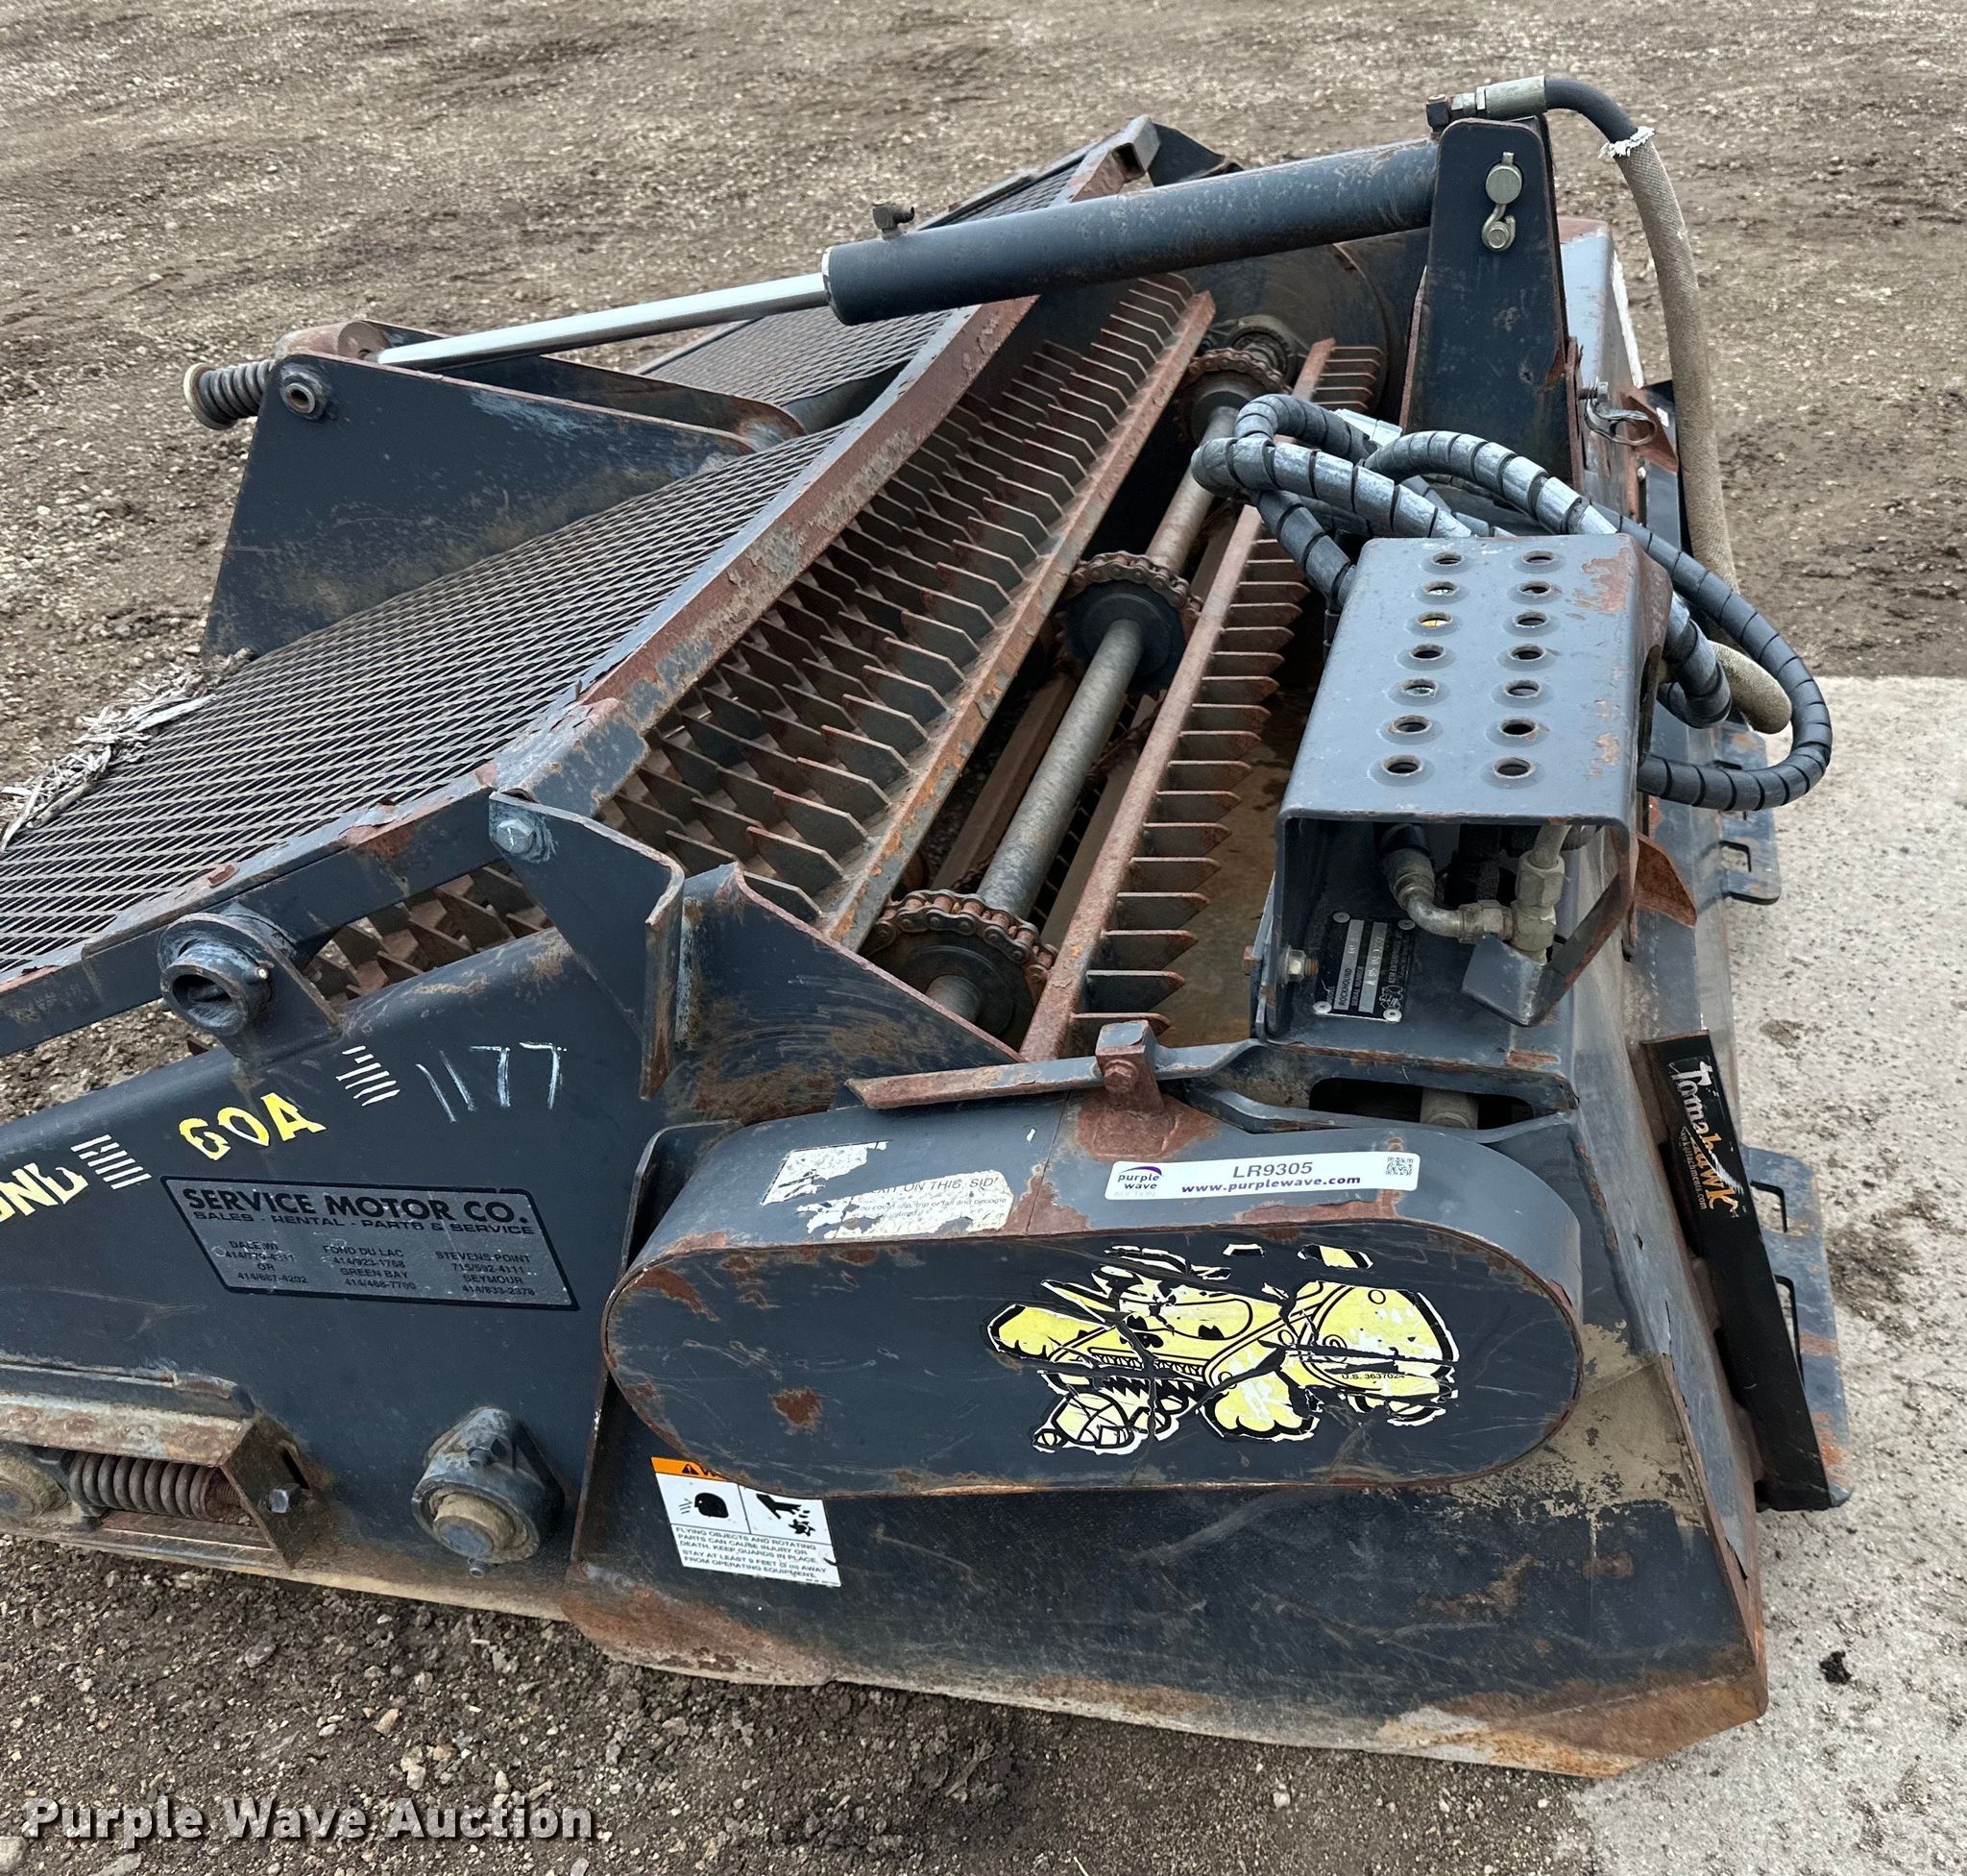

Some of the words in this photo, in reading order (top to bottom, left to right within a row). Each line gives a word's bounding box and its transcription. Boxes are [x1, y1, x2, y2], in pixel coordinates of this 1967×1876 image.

[1339, 967, 1352, 1007] ROCKHOUND
[1117, 1173, 1160, 1182] purple
[1232, 1161, 1313, 1179] LR9305
[1181, 1177, 1360, 1192] www.purplewave.com
[182, 1188, 316, 1215] SERVICE
[324, 1194, 456, 1221] MOTOR
[464, 1201, 528, 1224] CO.
[193, 1211, 255, 1222] SALES
[360, 1219, 425, 1230] PARTS
[432, 1222, 445, 1231] &
[450, 1223, 535, 1235] SERVICE
[323, 1245, 356, 1255] FOND
[358, 1247, 376, 1255] DU
[378, 1248, 404, 1257] LAC
[435, 1251, 492, 1262] STEVENS
[495, 1254, 530, 1263] POINT
[256, 1262, 276, 1271] OR
[340, 1267, 381, 1278] GREEN
[383, 1270, 407, 1279] BAY
[462, 1274, 523, 1284] SEYMOUR
[675, 1526, 708, 1536] FLYING
[709, 1531, 749, 1542] OBJECTS
[771, 1539, 816, 1550] ROTATING
[677, 1534, 707, 1543] PARTS
[729, 1541, 758, 1549] CAUSE
[760, 1545, 792, 1553] INJURY
[738, 1547, 775, 1558] GUARDS
[684, 1556, 710, 1565] FROM
[711, 1560, 762, 1571] OPERATING
[719, 1554, 746, 1563] LEAST
[801, 1565, 827, 1573] AWAY
